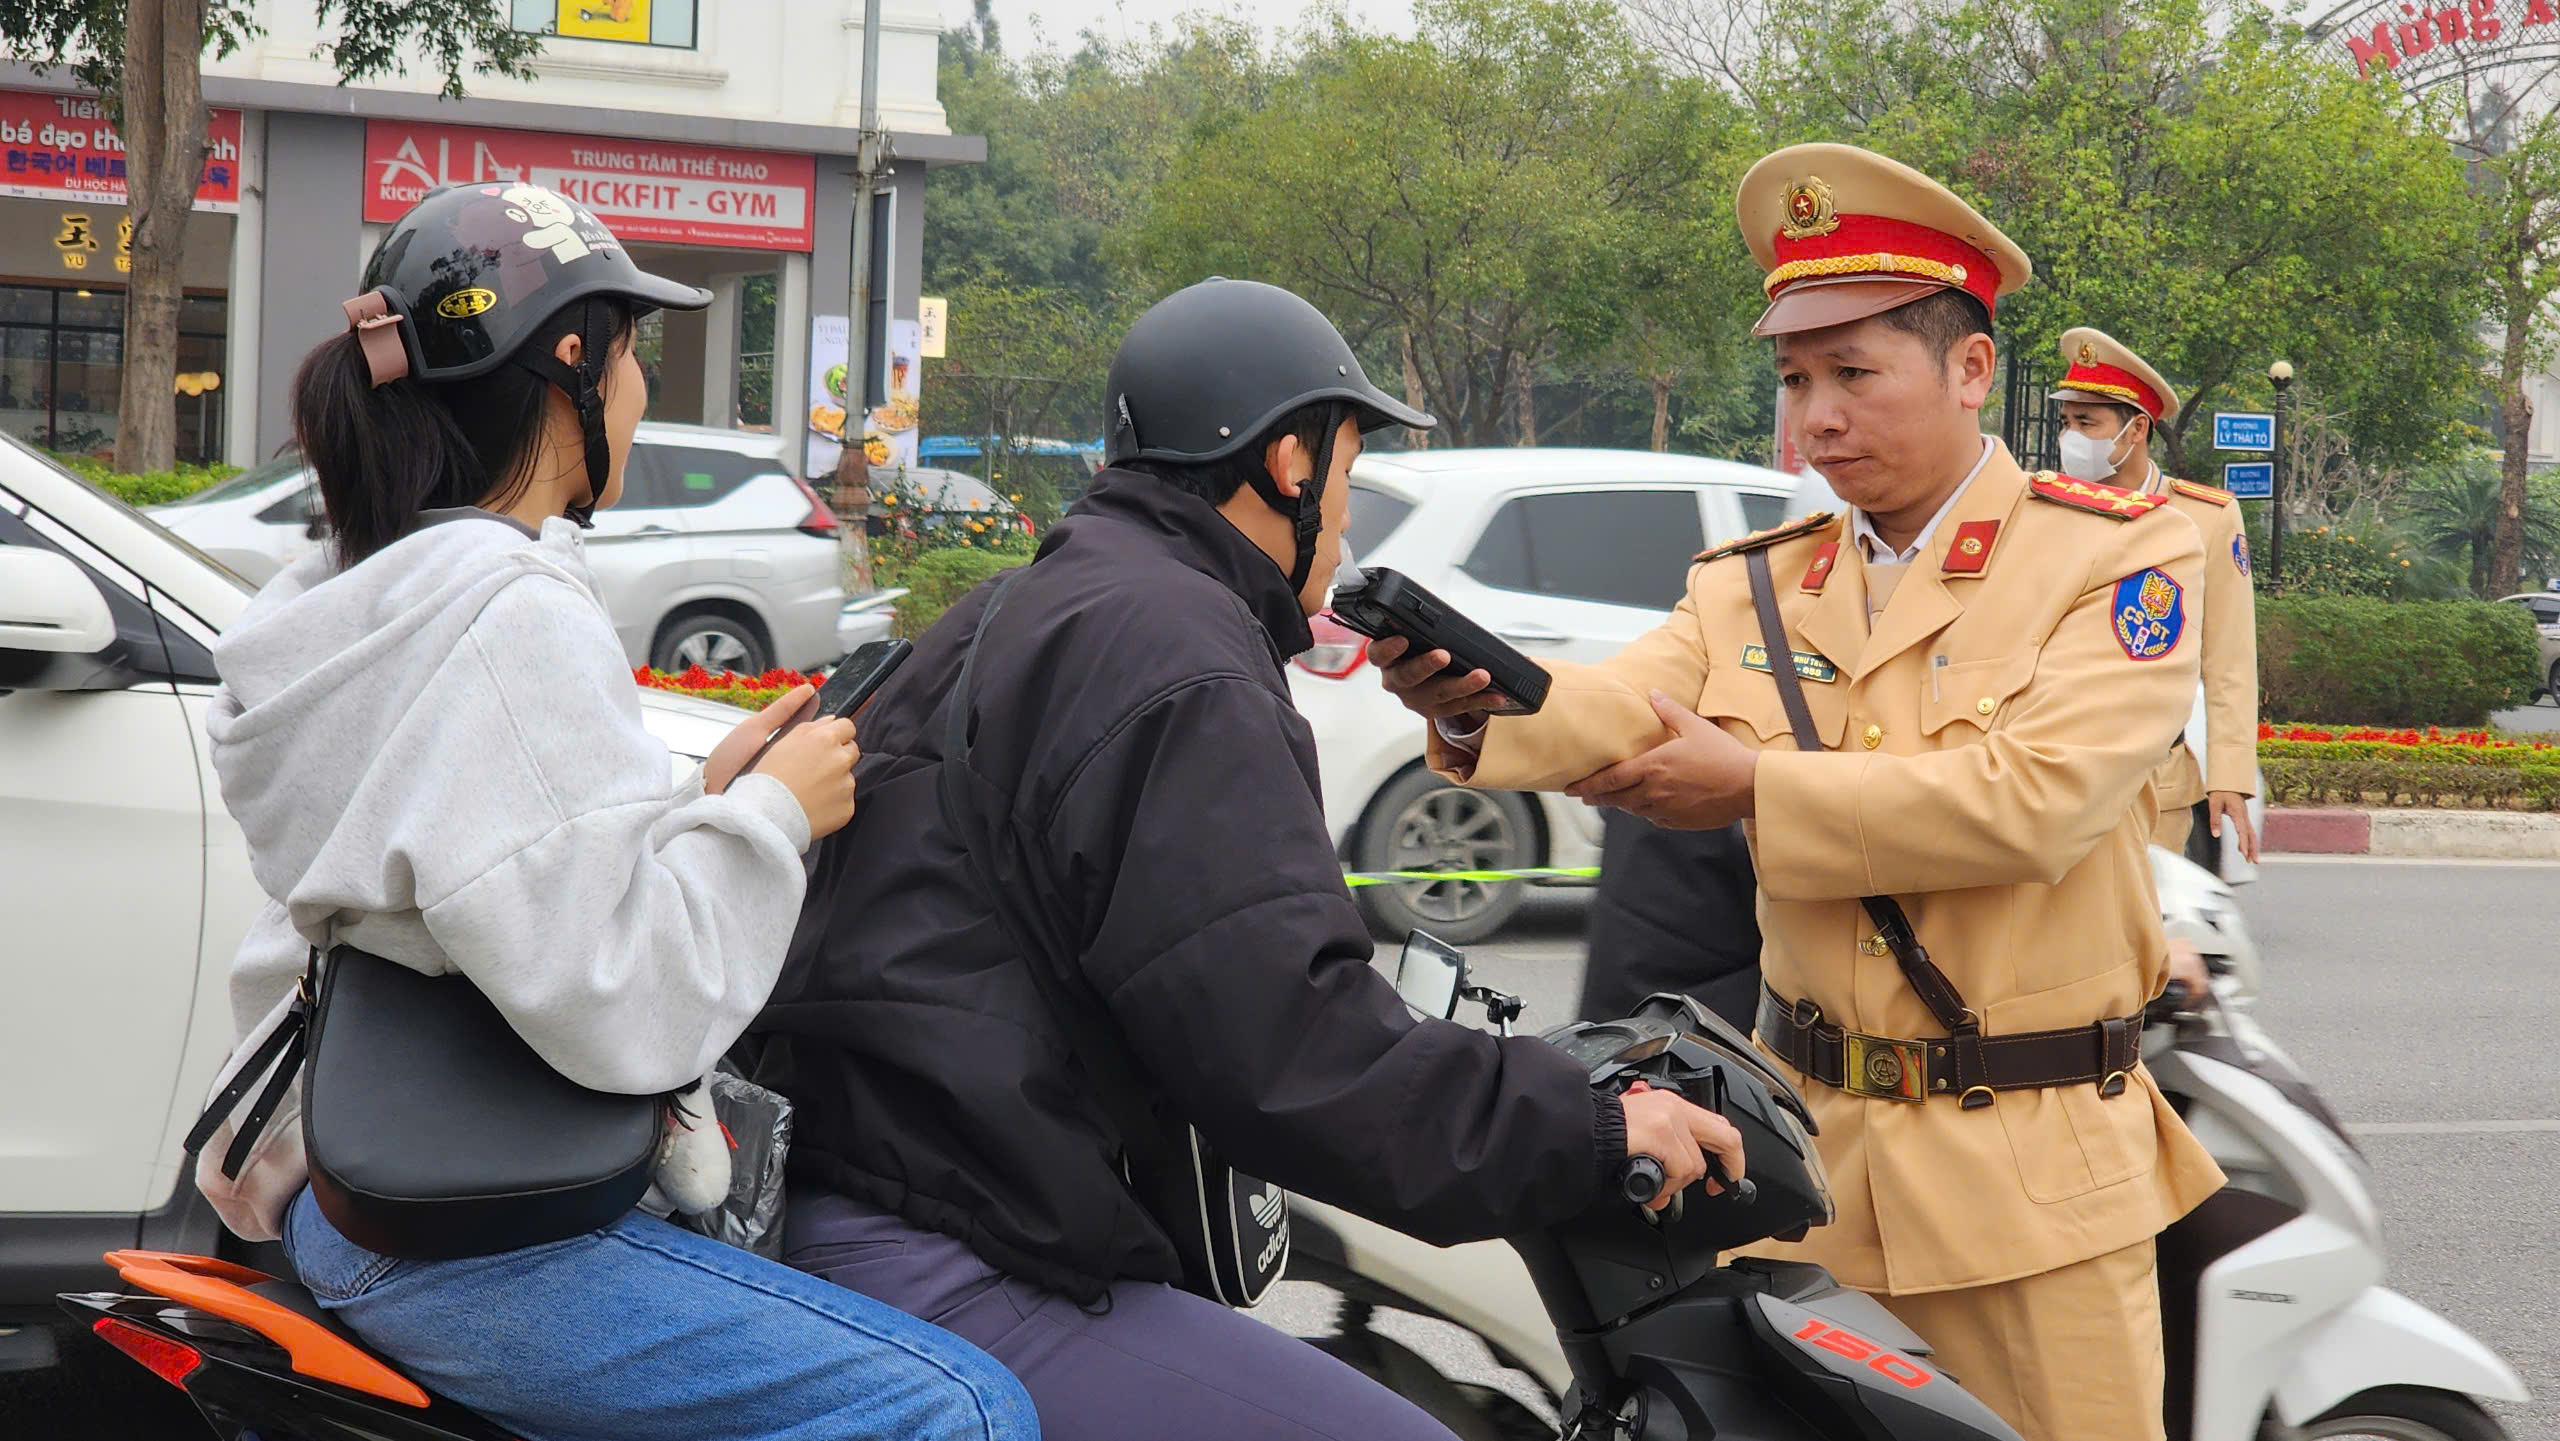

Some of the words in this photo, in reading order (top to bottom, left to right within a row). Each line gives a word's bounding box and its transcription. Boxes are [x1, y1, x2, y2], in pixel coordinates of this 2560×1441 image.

[2346, 0, 2501, 82] Mừng
[2522, 0, 2560, 27] X
[1, 119, 33, 145] bá
[39, 122, 87, 152] đạo
[93, 128, 126, 151] th
[211, 137, 236, 161] nh
[7, 149, 76, 174] 한국어
[85, 156, 127, 178] 베트
[572, 149, 634, 169] TRUNG
[637, 152, 677, 173] TÂM
[719, 162, 768, 181] THAO
[65, 177, 81, 189] DU
[111, 178, 127, 192] HÀ
[379, 185, 426, 202] KICKF
[559, 178, 682, 211] KICKFIT
[706, 189, 777, 218] GYM
[66, 255, 84, 266] YU
[2123, 605, 2146, 626] CS
[2149, 620, 2171, 641] GT
[1793, 1318, 1934, 1389] 150
